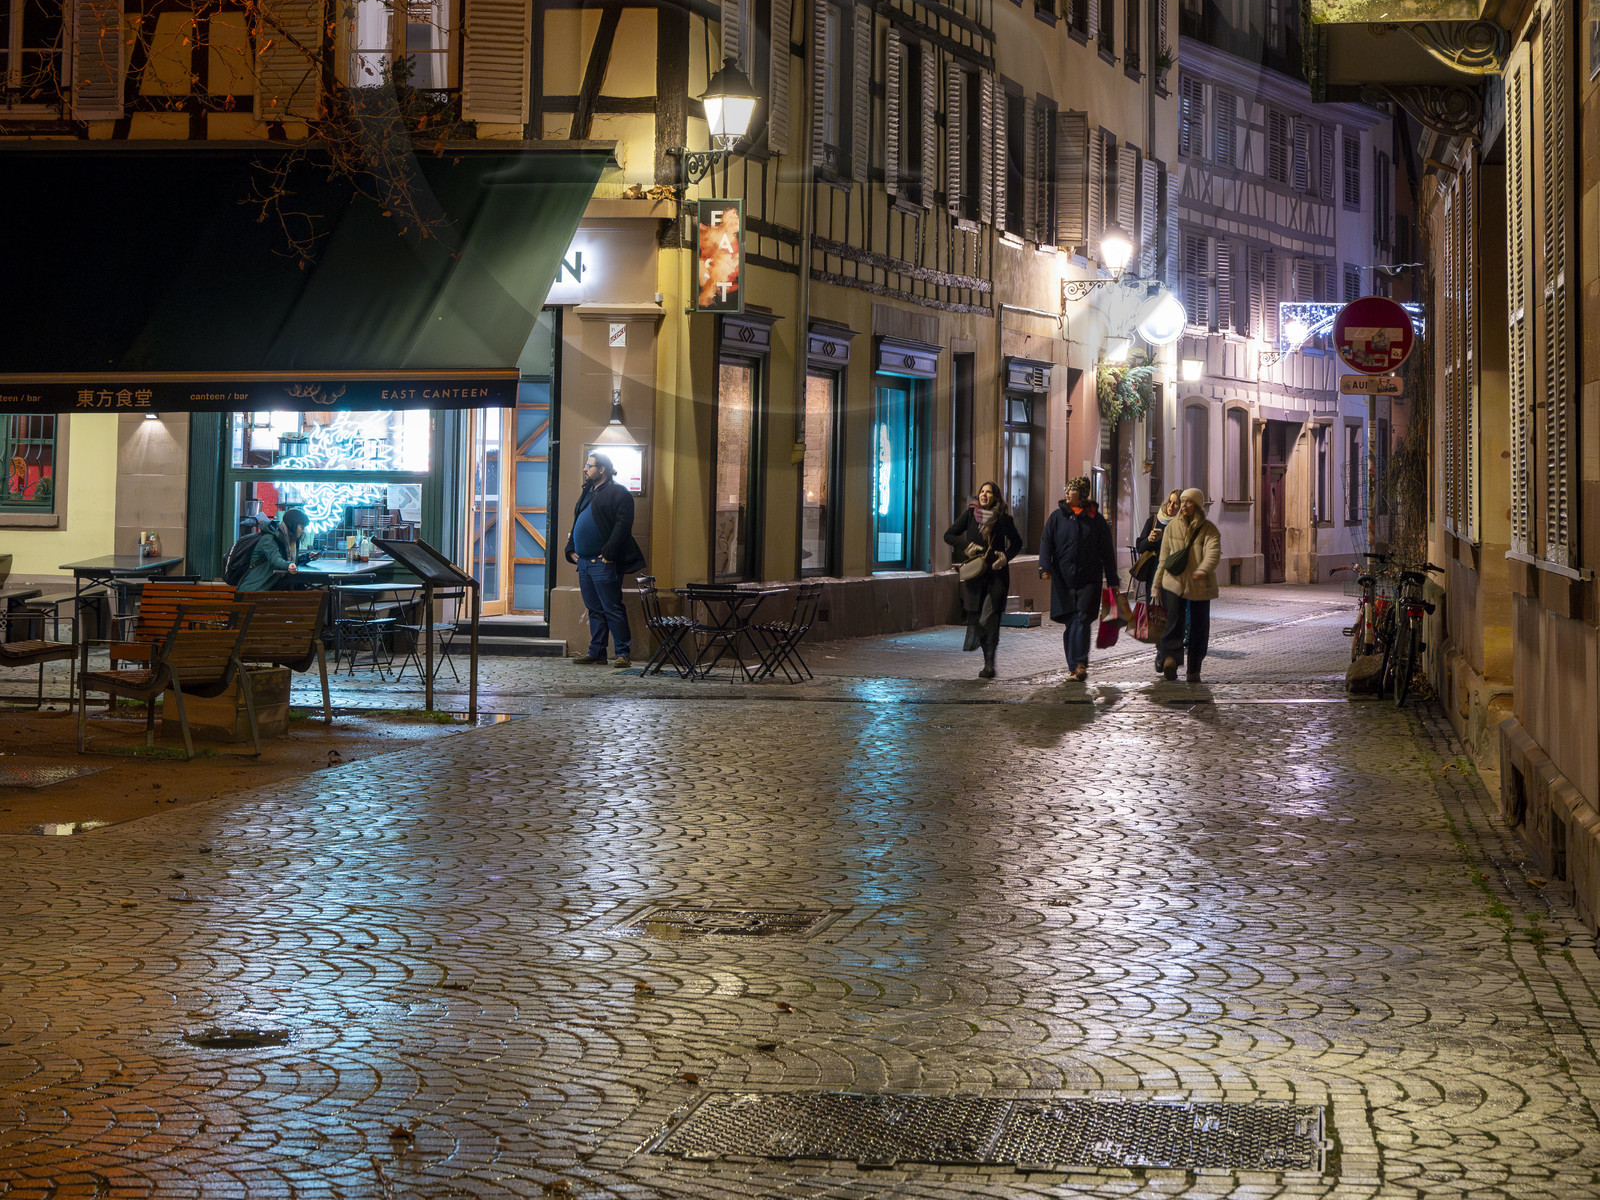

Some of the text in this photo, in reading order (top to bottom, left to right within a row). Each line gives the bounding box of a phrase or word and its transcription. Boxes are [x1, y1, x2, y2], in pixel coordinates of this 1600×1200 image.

[26, 394, 41, 402] bar
[76, 388, 154, 408] 東方食堂
[189, 393, 226, 401] canteen
[233, 392, 249, 401] bar
[381, 388, 489, 400] EAST CANTEEN
